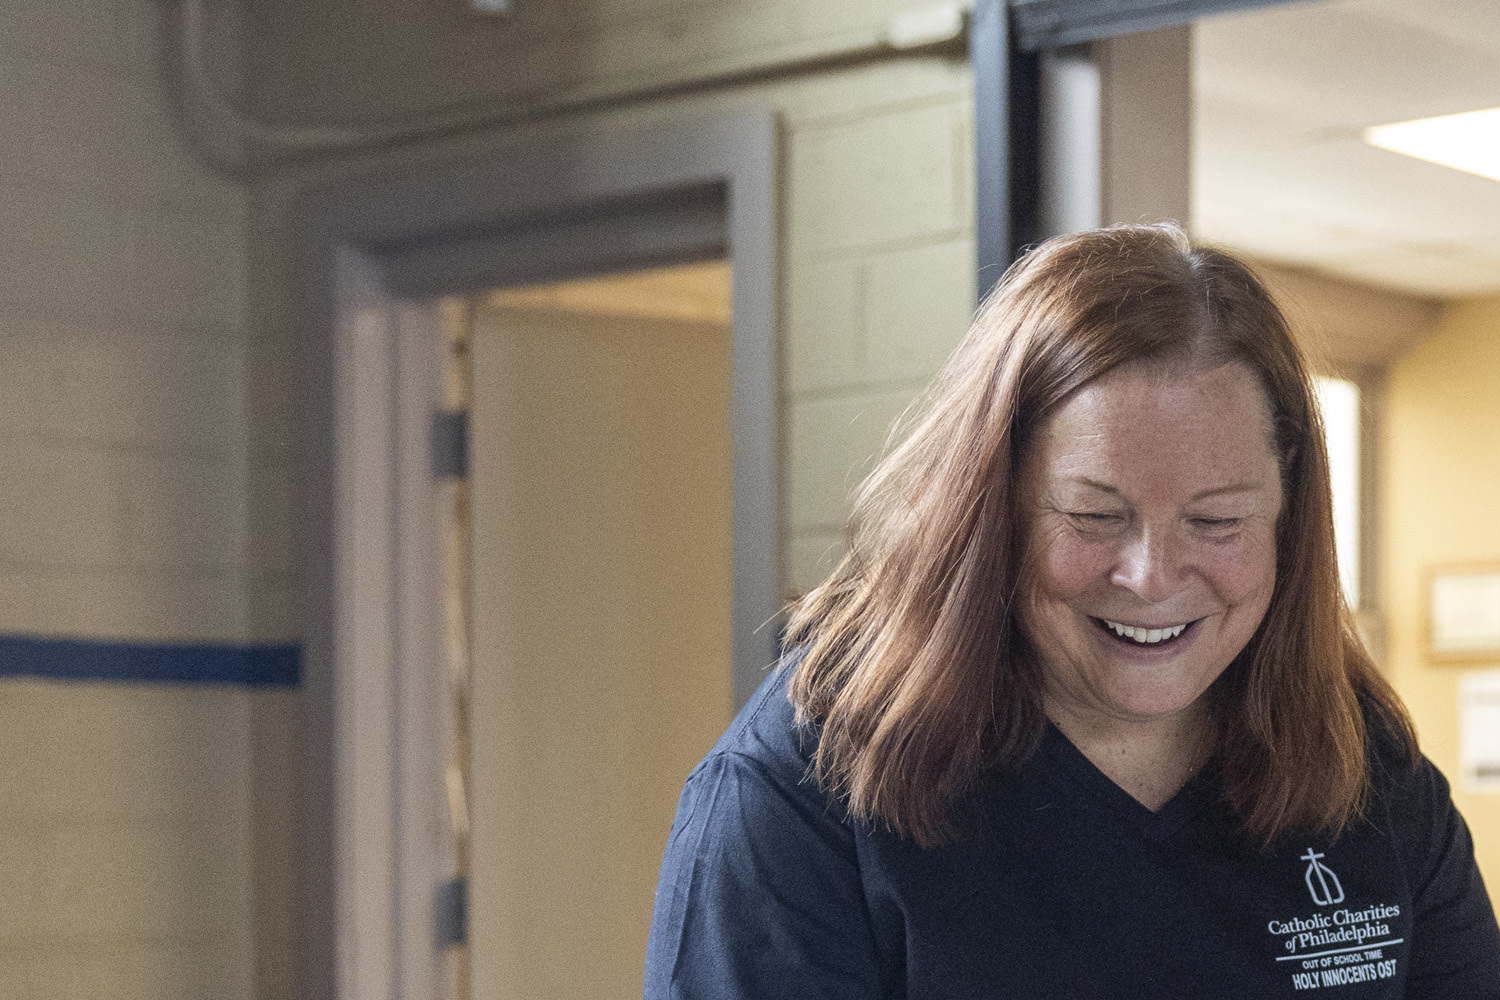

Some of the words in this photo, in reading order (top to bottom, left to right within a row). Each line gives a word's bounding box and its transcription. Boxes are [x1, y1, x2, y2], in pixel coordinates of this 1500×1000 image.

[1268, 913, 1331, 935] Catholic
[1333, 903, 1400, 926] Charities
[1285, 936, 1297, 953] of
[1299, 921, 1390, 949] Philadelphia
[1292, 971, 1320, 990] HOLY
[1321, 963, 1376, 988] INNOCENTS
[1378, 958, 1397, 978] OST
[1302, 959, 1320, 970] OUT
[1321, 957, 1332, 967] OF
[1333, 953, 1364, 966] SCHOOL
[1364, 949, 1383, 961] TIME
